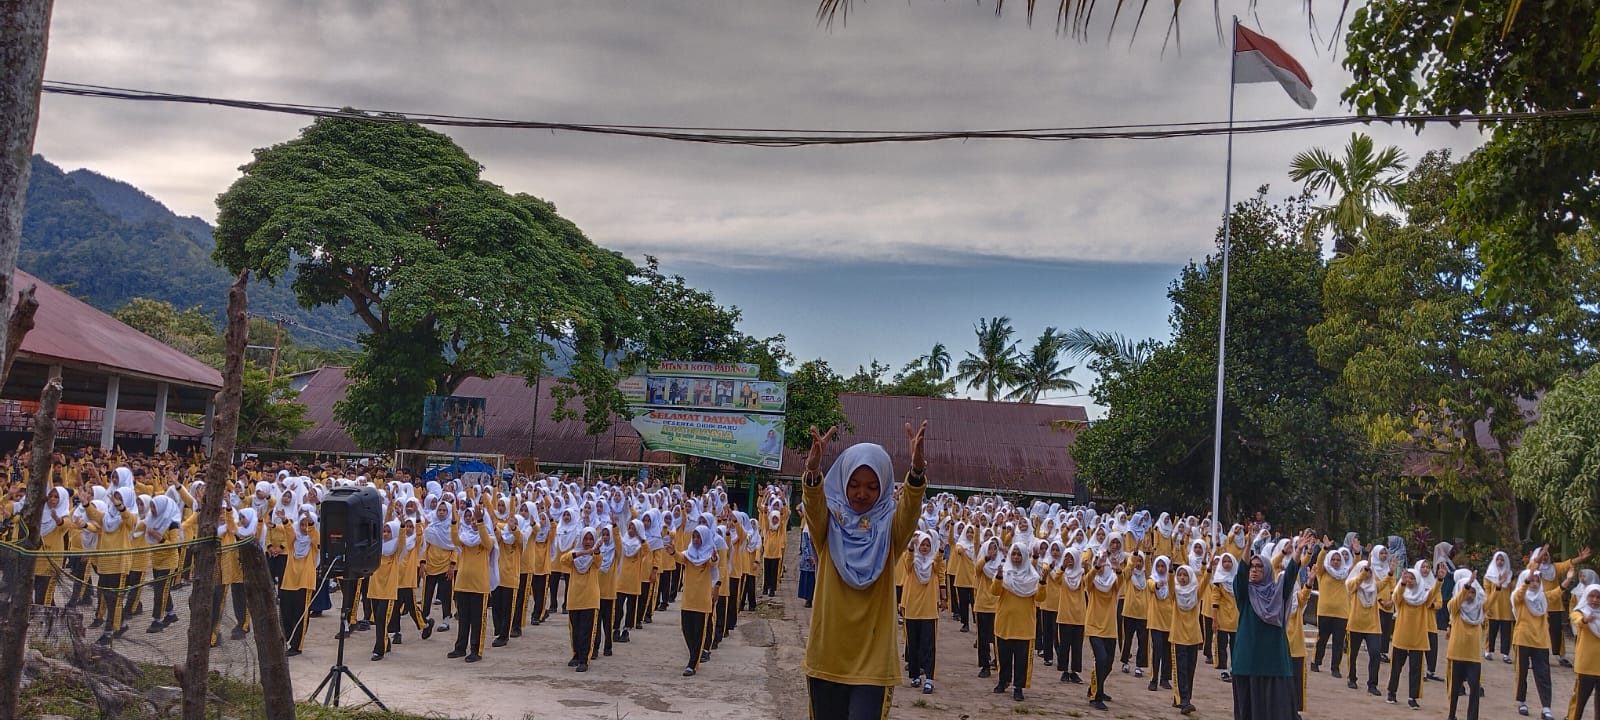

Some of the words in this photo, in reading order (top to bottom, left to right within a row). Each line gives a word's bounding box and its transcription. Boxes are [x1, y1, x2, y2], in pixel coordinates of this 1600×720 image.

[691, 364, 712, 372] KOTA
[714, 364, 747, 373] PADANG
[649, 411, 700, 422] SELAMAT
[702, 415, 747, 425] DATANG
